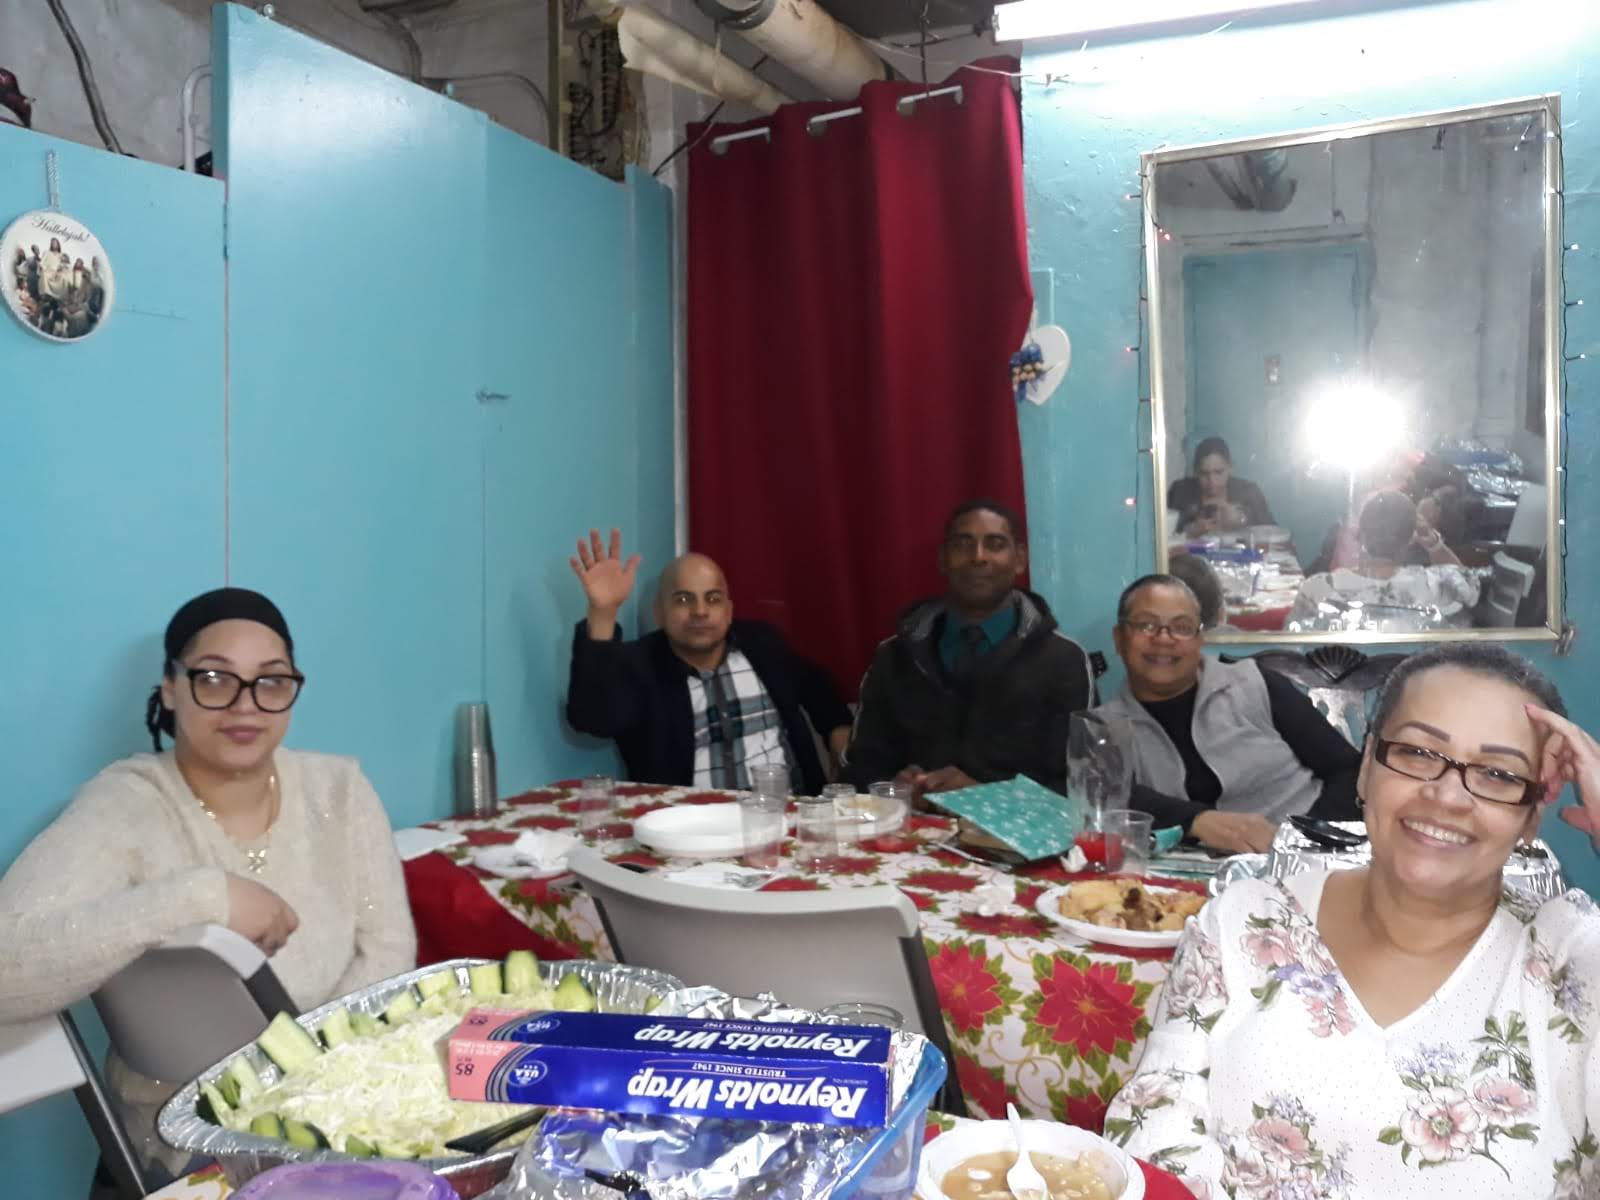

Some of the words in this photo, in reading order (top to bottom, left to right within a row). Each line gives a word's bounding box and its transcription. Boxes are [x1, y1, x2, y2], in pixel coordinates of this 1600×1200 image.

[634, 1024, 721, 1049] Wrap
[719, 1032, 872, 1057] Reynolds
[456, 1063, 475, 1076] 85
[692, 1062, 712, 1071] 1947
[715, 1064, 743, 1075] SINCE
[744, 1067, 786, 1077] TRUSTED
[627, 1067, 714, 1110] Wrap
[714, 1077, 868, 1118] Reynolds
